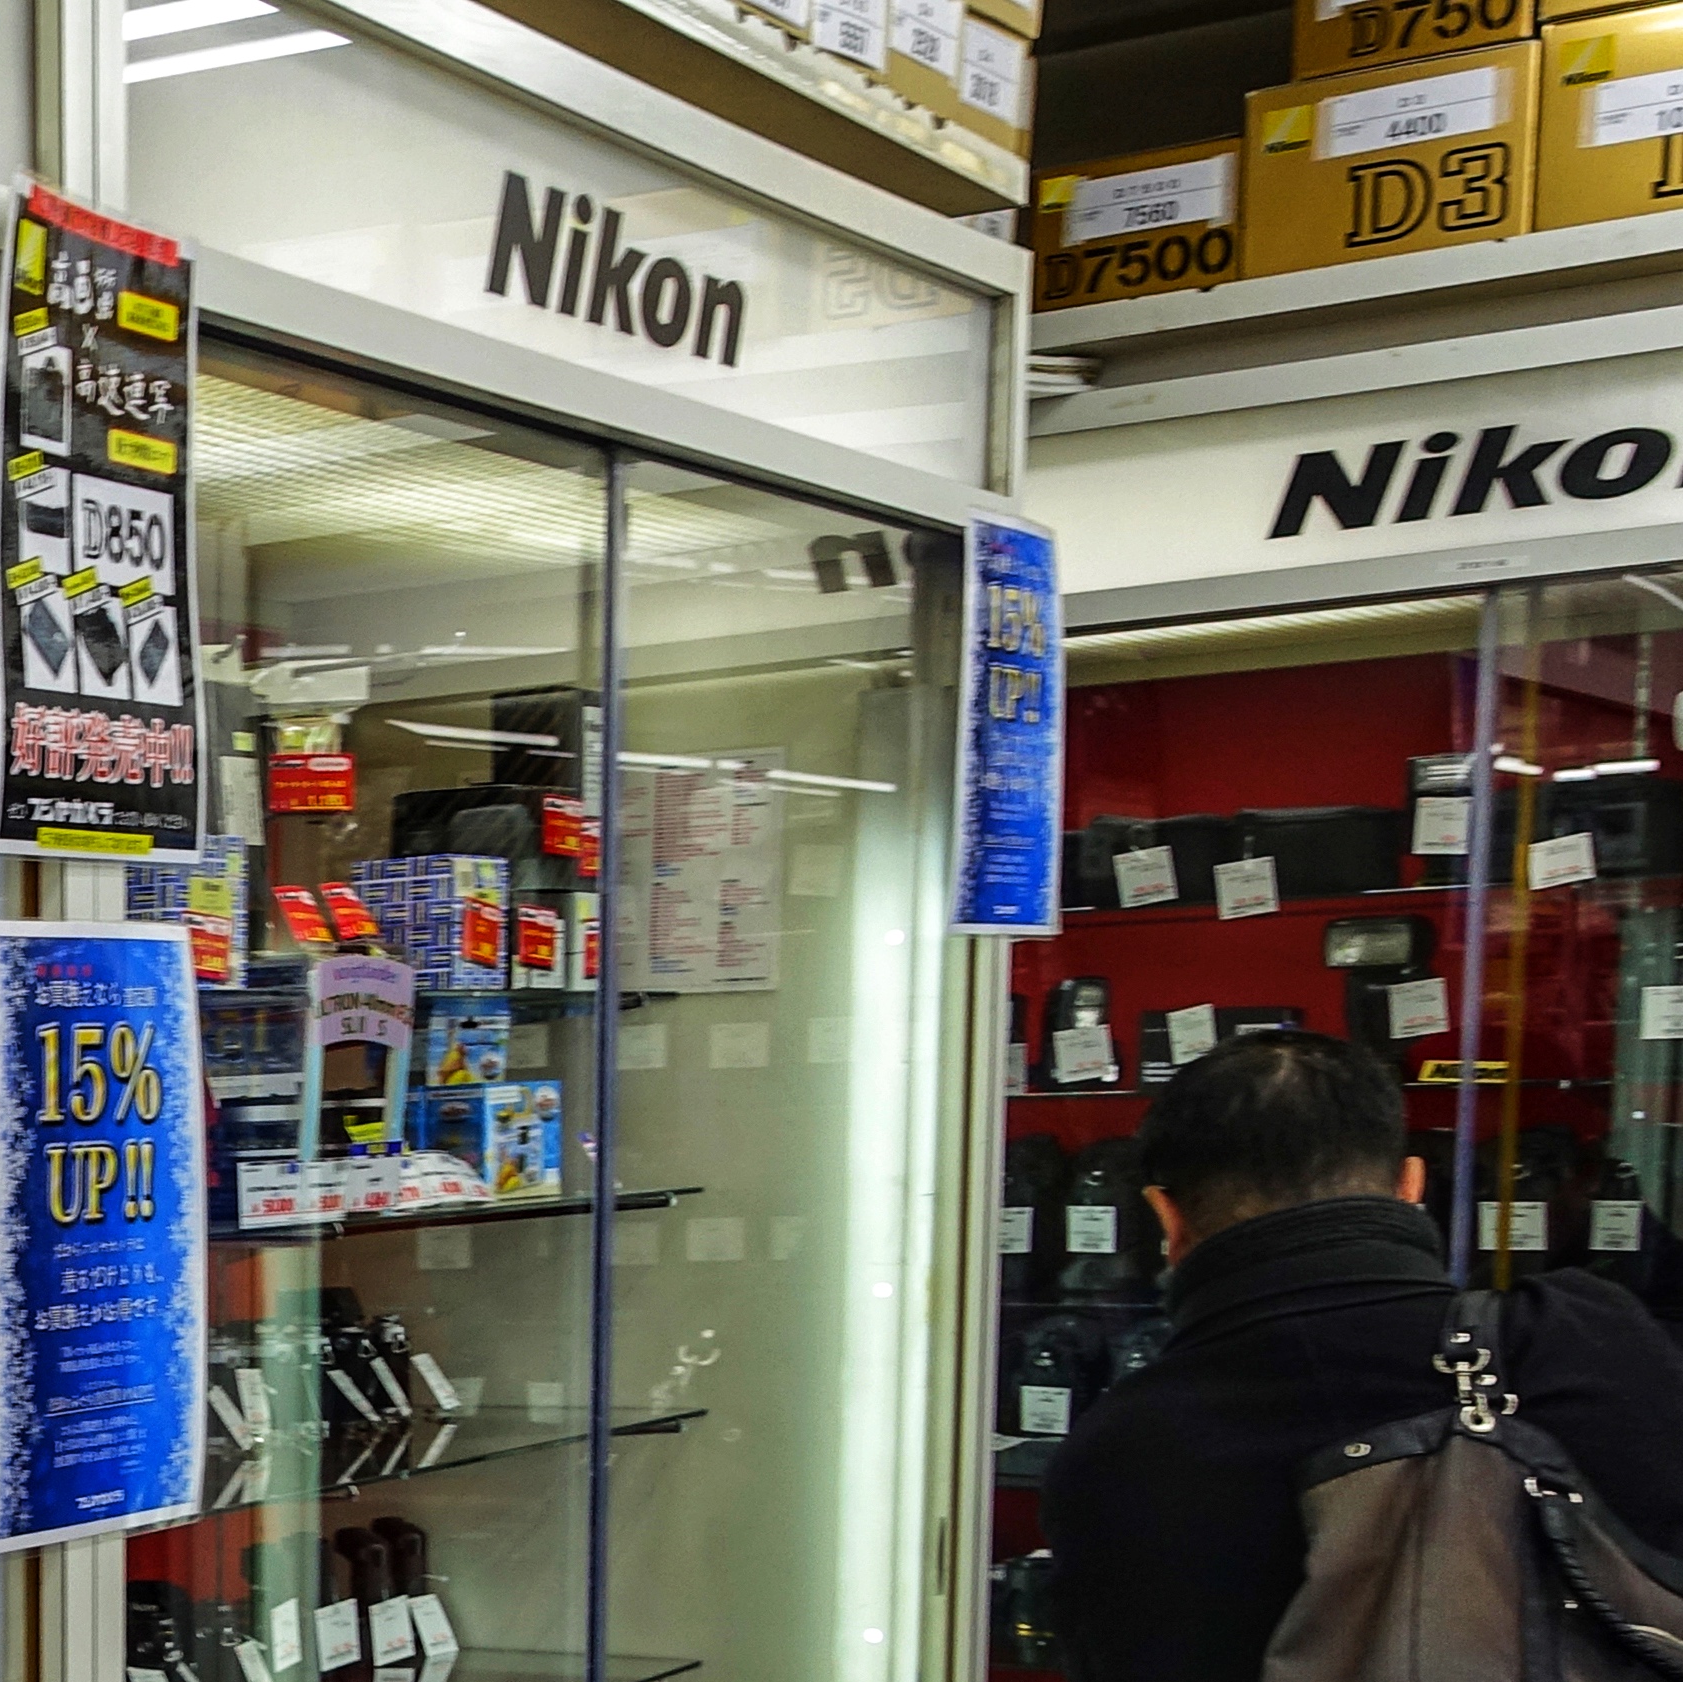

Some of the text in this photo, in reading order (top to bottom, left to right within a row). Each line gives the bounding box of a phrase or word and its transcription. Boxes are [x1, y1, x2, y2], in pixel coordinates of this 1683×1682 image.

[1345, 141, 1511, 250] D3
[486, 168, 747, 370] Nikon
[1043, 228, 1235, 301] D7500
[1267, 424, 1683, 542] Niko
[81, 497, 167, 574] D850
[36, 1021, 163, 1125] 15%
[45, 1139, 157, 1226] UP!!
